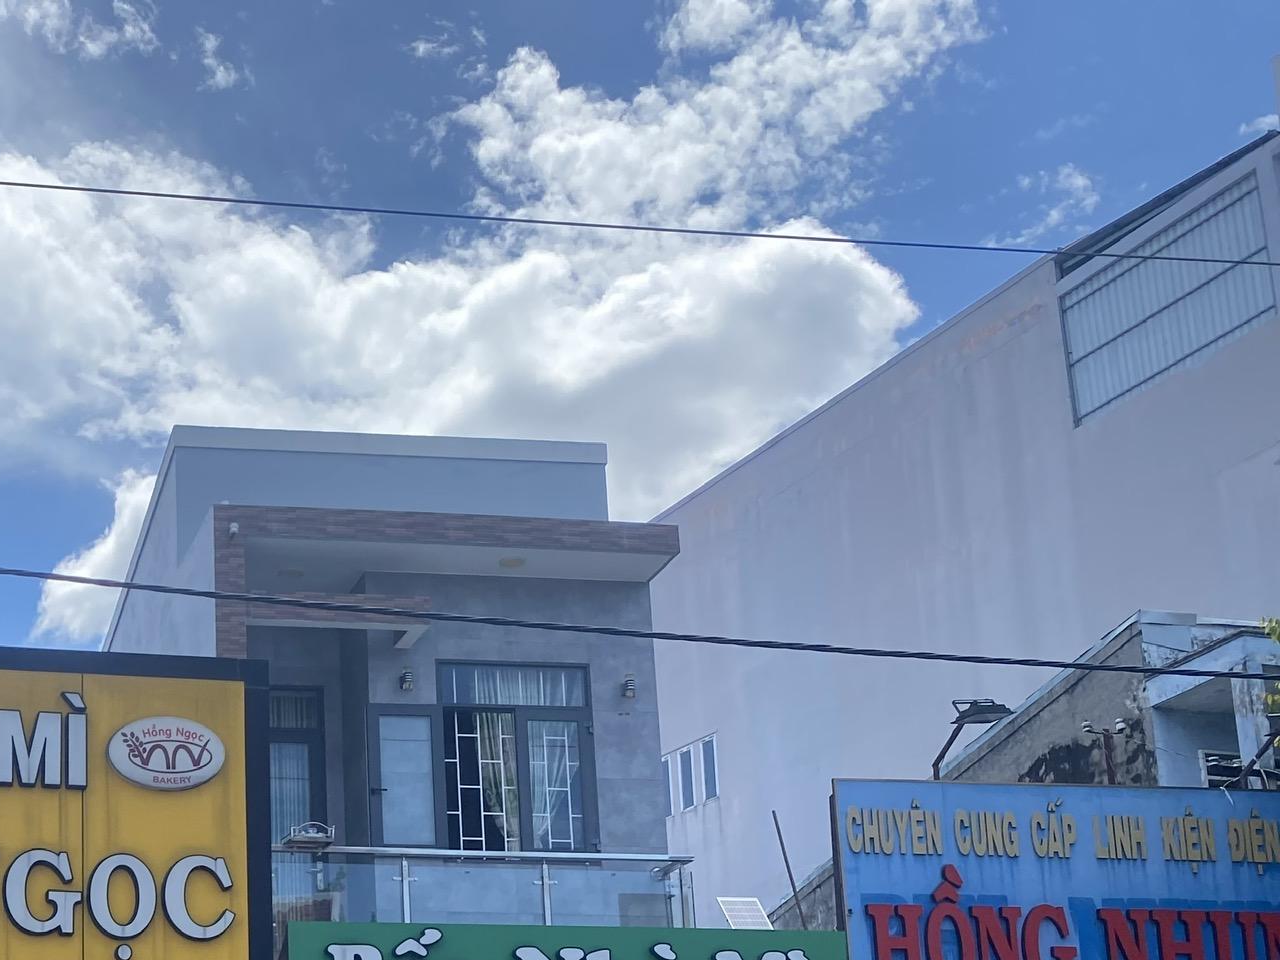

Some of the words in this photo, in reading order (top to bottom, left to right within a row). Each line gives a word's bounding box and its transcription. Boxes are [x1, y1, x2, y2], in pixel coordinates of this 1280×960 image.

[153, 775, 192, 785] BAKERY
[846, 799, 943, 856] CHUYÊN
[954, 808, 1019, 858] CUNG
[1031, 798, 1077, 859] CẤP
[1092, 815, 1147, 861] LINH
[1160, 805, 1217, 875] KIỆN
